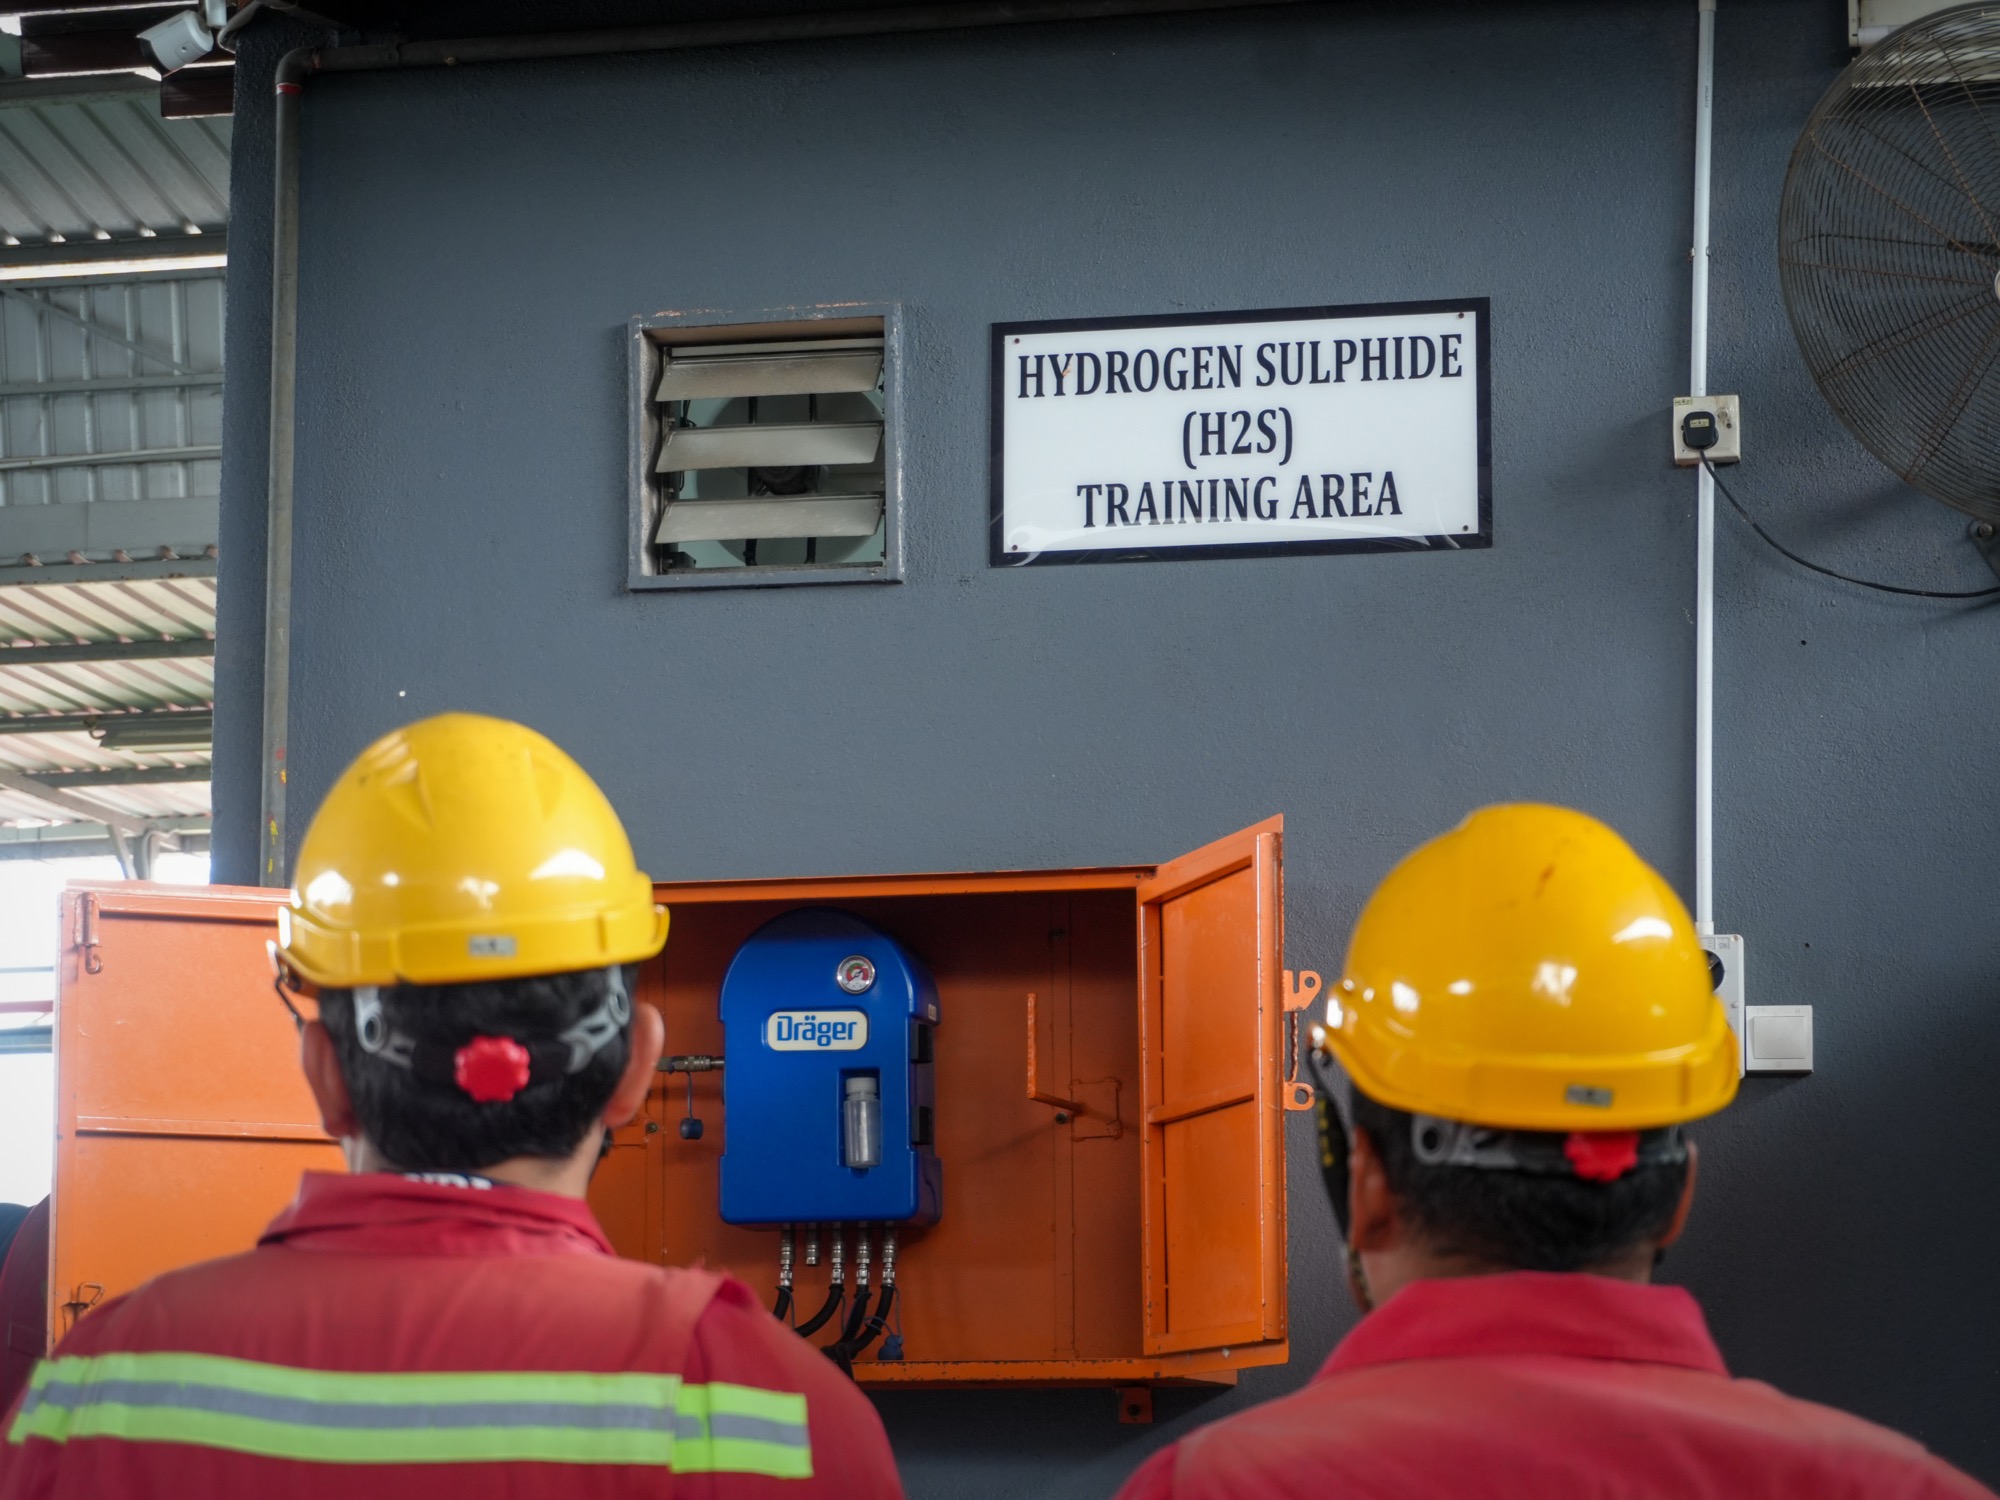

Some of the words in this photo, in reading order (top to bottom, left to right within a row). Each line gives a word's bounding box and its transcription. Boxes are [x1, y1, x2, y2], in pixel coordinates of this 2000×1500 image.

[1018, 344, 1243, 398] HYDROGEN
[1256, 333, 1463, 388] SULPHIDE
[1181, 406, 1294, 470] (H2S)
[1076, 475, 1278, 528] TRAINING
[1290, 471, 1403, 520] AREA
[776, 1014, 857, 1047] Dräger
